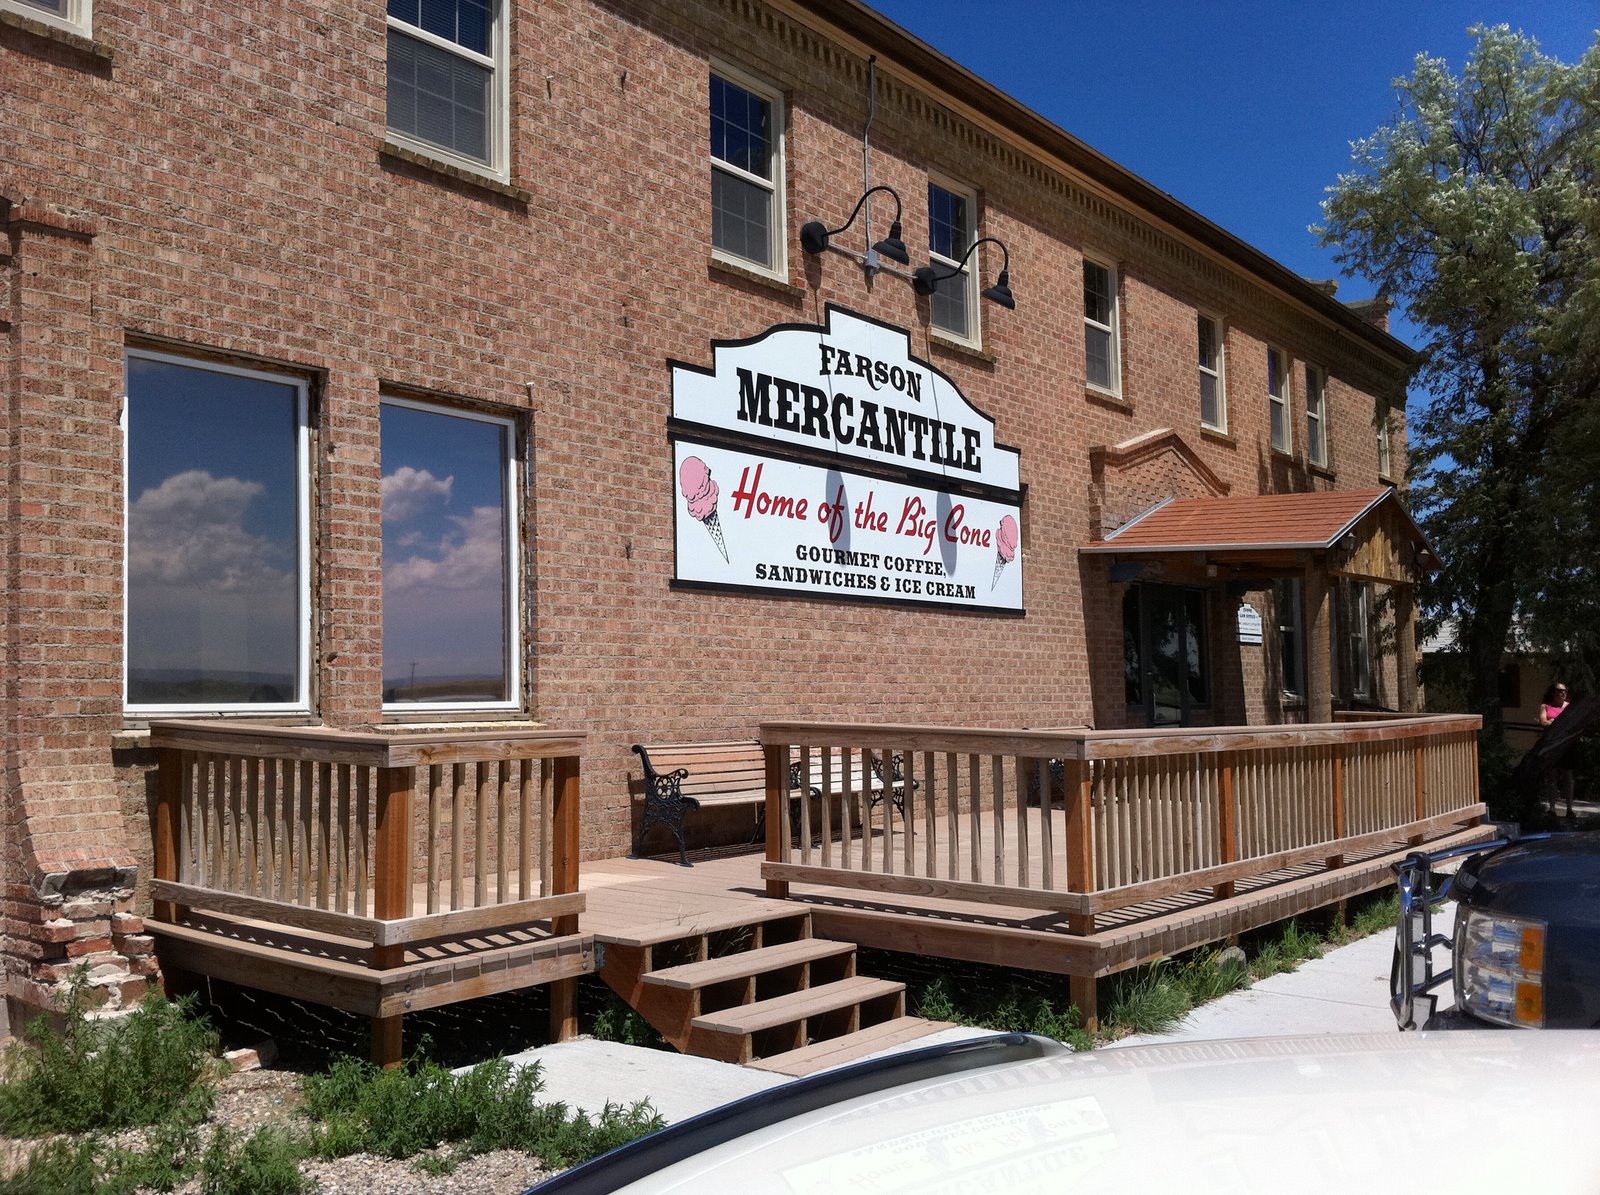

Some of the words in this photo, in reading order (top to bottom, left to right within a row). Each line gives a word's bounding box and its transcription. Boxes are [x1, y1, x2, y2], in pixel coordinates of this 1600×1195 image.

[819, 343, 922, 402] FARSON
[736, 367, 982, 474] MERCANTILE
[731, 462, 809, 520] Home
[817, 484, 845, 544] of
[854, 491, 888, 533] the
[895, 496, 936, 555] Big
[944, 503, 991, 548] Cone
[755, 563, 877, 590] SANDWICHES
[880, 579, 891, 592] &
[895, 578, 922, 595] ICE
[926, 580, 976, 600] CREAM
[795, 544, 880, 570] GOURMET
